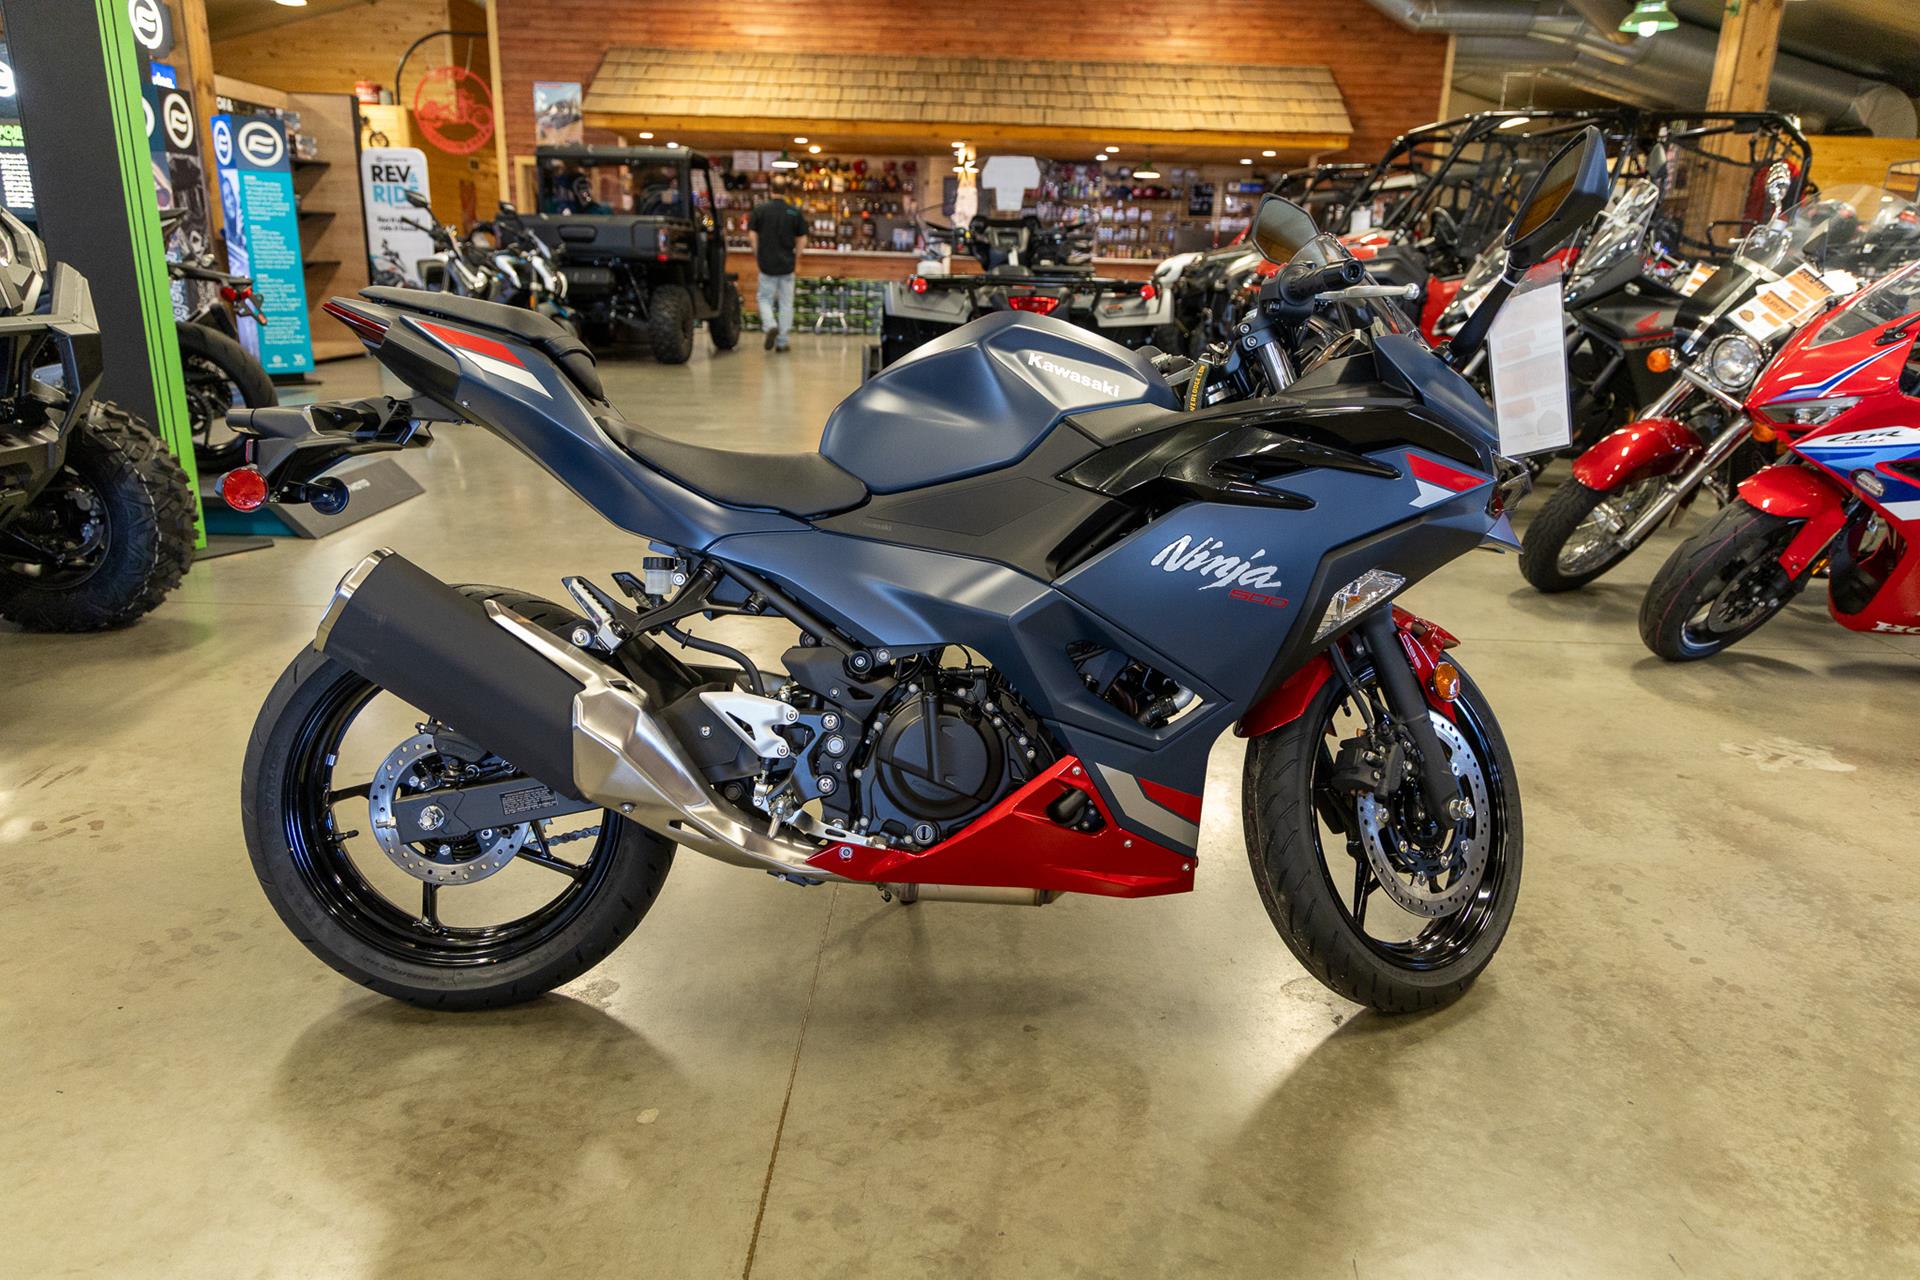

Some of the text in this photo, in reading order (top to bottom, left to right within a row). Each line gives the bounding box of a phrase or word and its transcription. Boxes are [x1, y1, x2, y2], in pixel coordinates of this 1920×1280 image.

[371, 165, 410, 182] REV
[1028, 351, 1120, 398] Kawasaki
[1826, 430, 1904, 443] CBR
[1150, 534, 1282, 590] Ninja
[1228, 588, 1290, 609] 500
